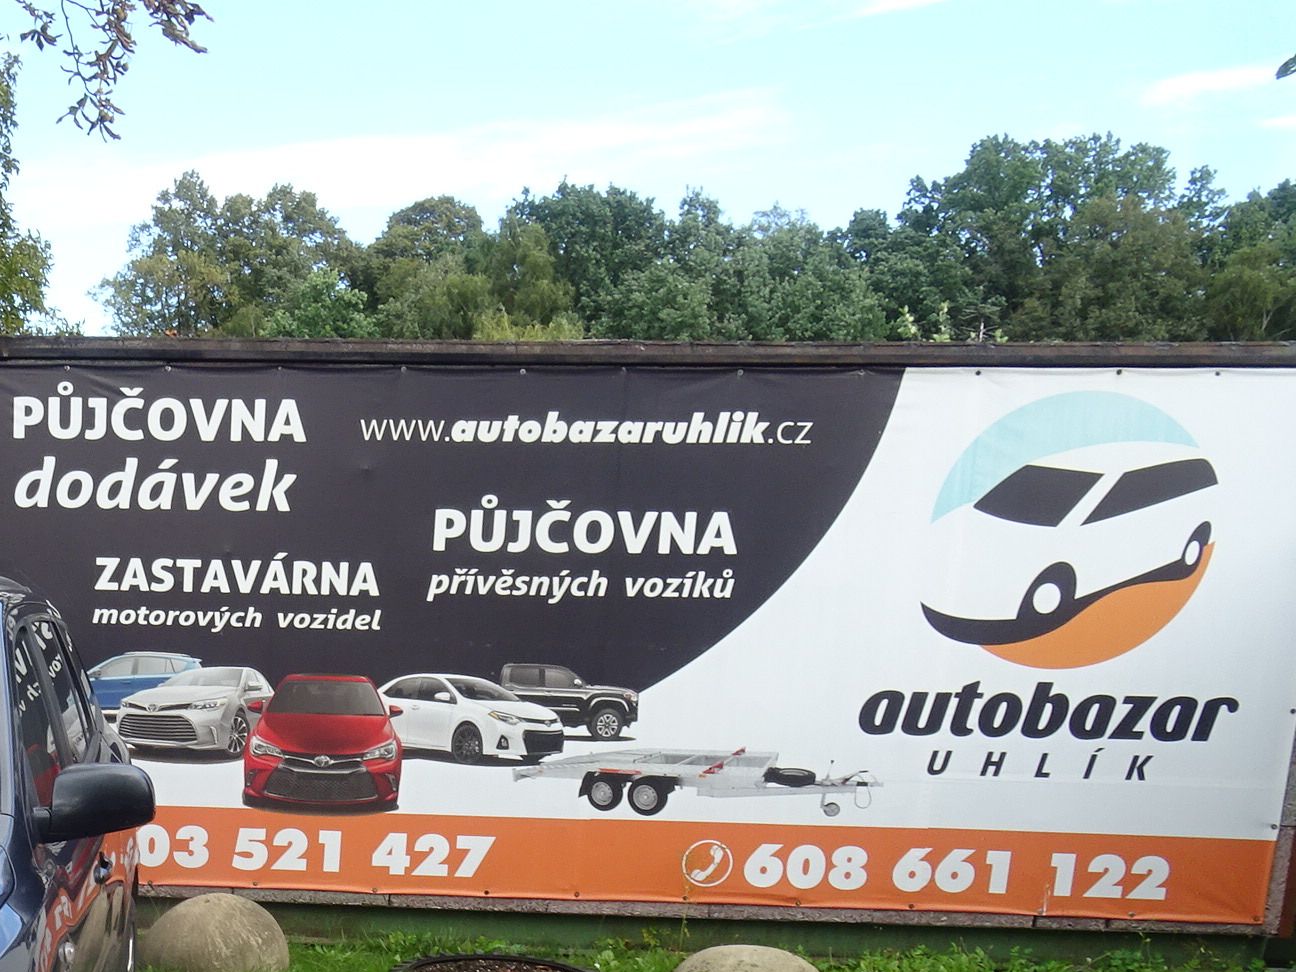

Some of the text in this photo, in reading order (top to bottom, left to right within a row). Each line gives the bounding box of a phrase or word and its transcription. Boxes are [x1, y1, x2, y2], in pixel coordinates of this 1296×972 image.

[12, 380, 307, 443] PŮJČOVNA
[360, 410, 814, 445] www.autobazaruhlik.cz
[14, 455, 298, 512] dodávek
[432, 494, 738, 555] PŮJČOVNA
[94, 551, 380, 597] ZASTAVÁRNA
[426, 567, 735, 604] přívěsných vozíků
[92, 606, 382, 633] motorových vozidel
[858, 680, 1240, 742] autobazar
[927, 747, 1154, 781] UHLÍK
[136, 823, 497, 878] 03 521 427
[743, 843, 1170, 900] 608 661 122
